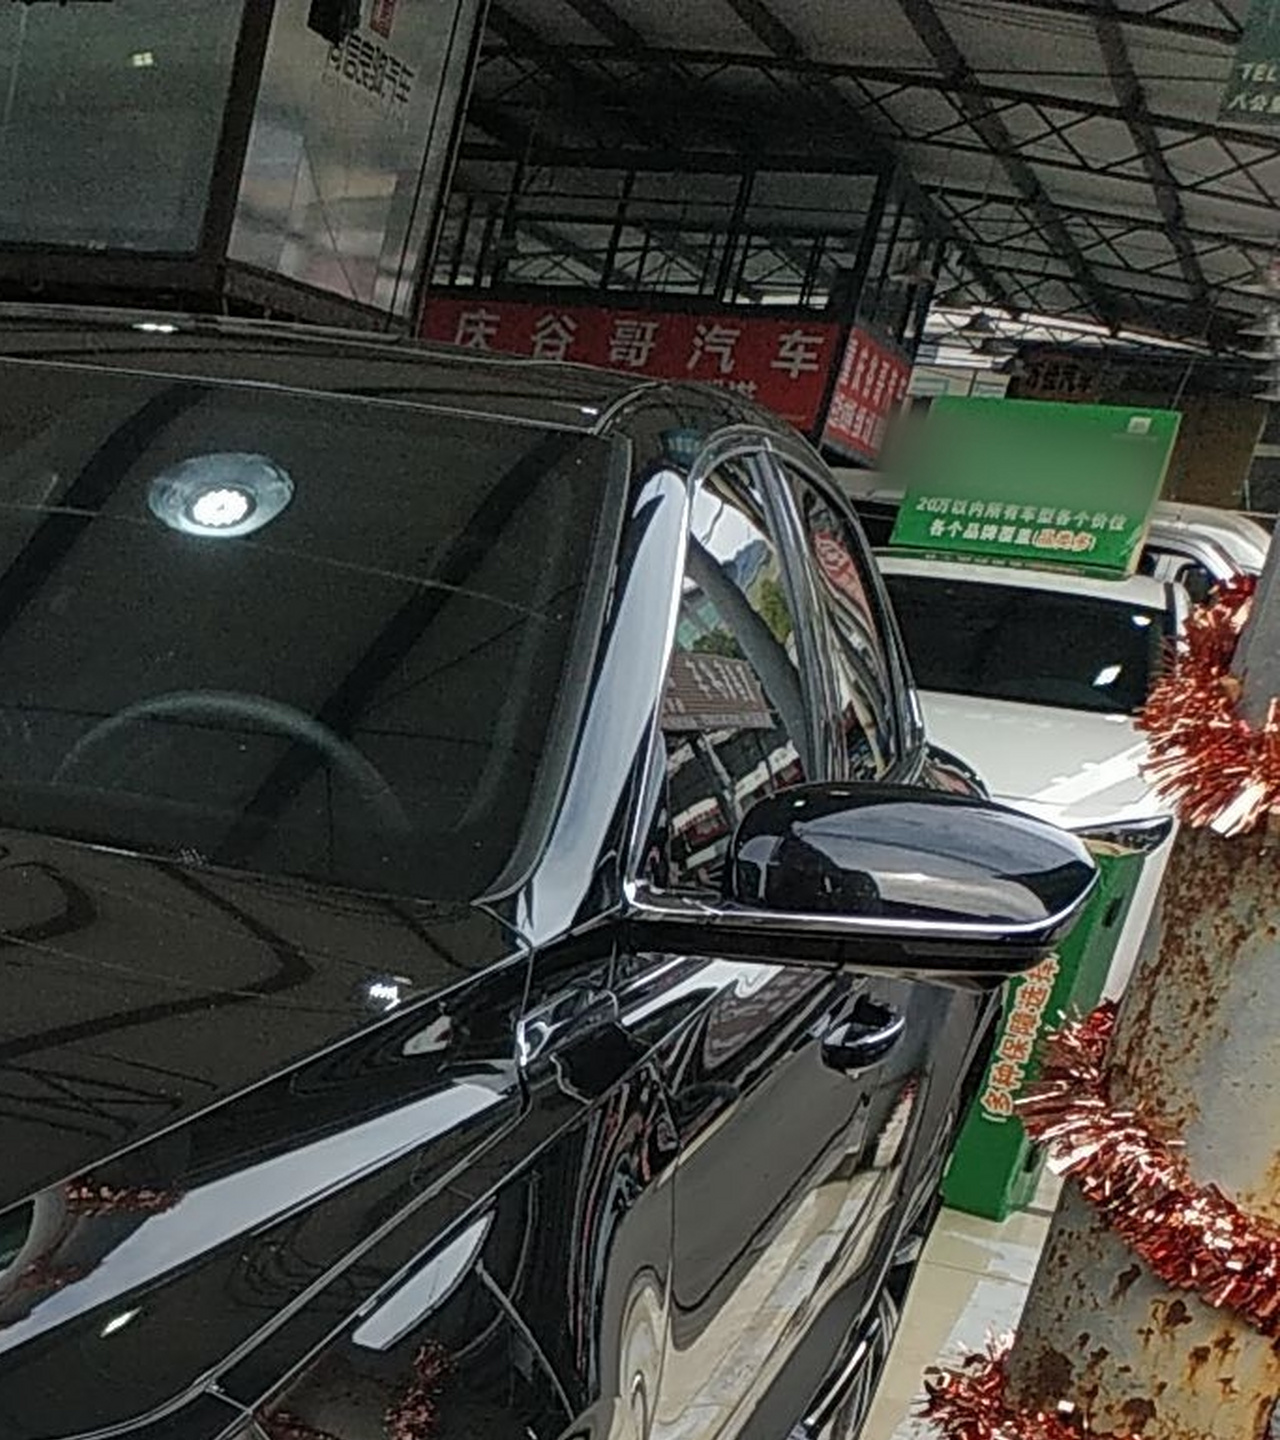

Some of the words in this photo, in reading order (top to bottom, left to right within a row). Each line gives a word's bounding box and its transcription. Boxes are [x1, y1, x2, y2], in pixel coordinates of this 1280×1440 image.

[453, 307, 825, 380] 庆谷哥汽车
[915, 495, 1128, 532] 20万以内所有车型各个价位
